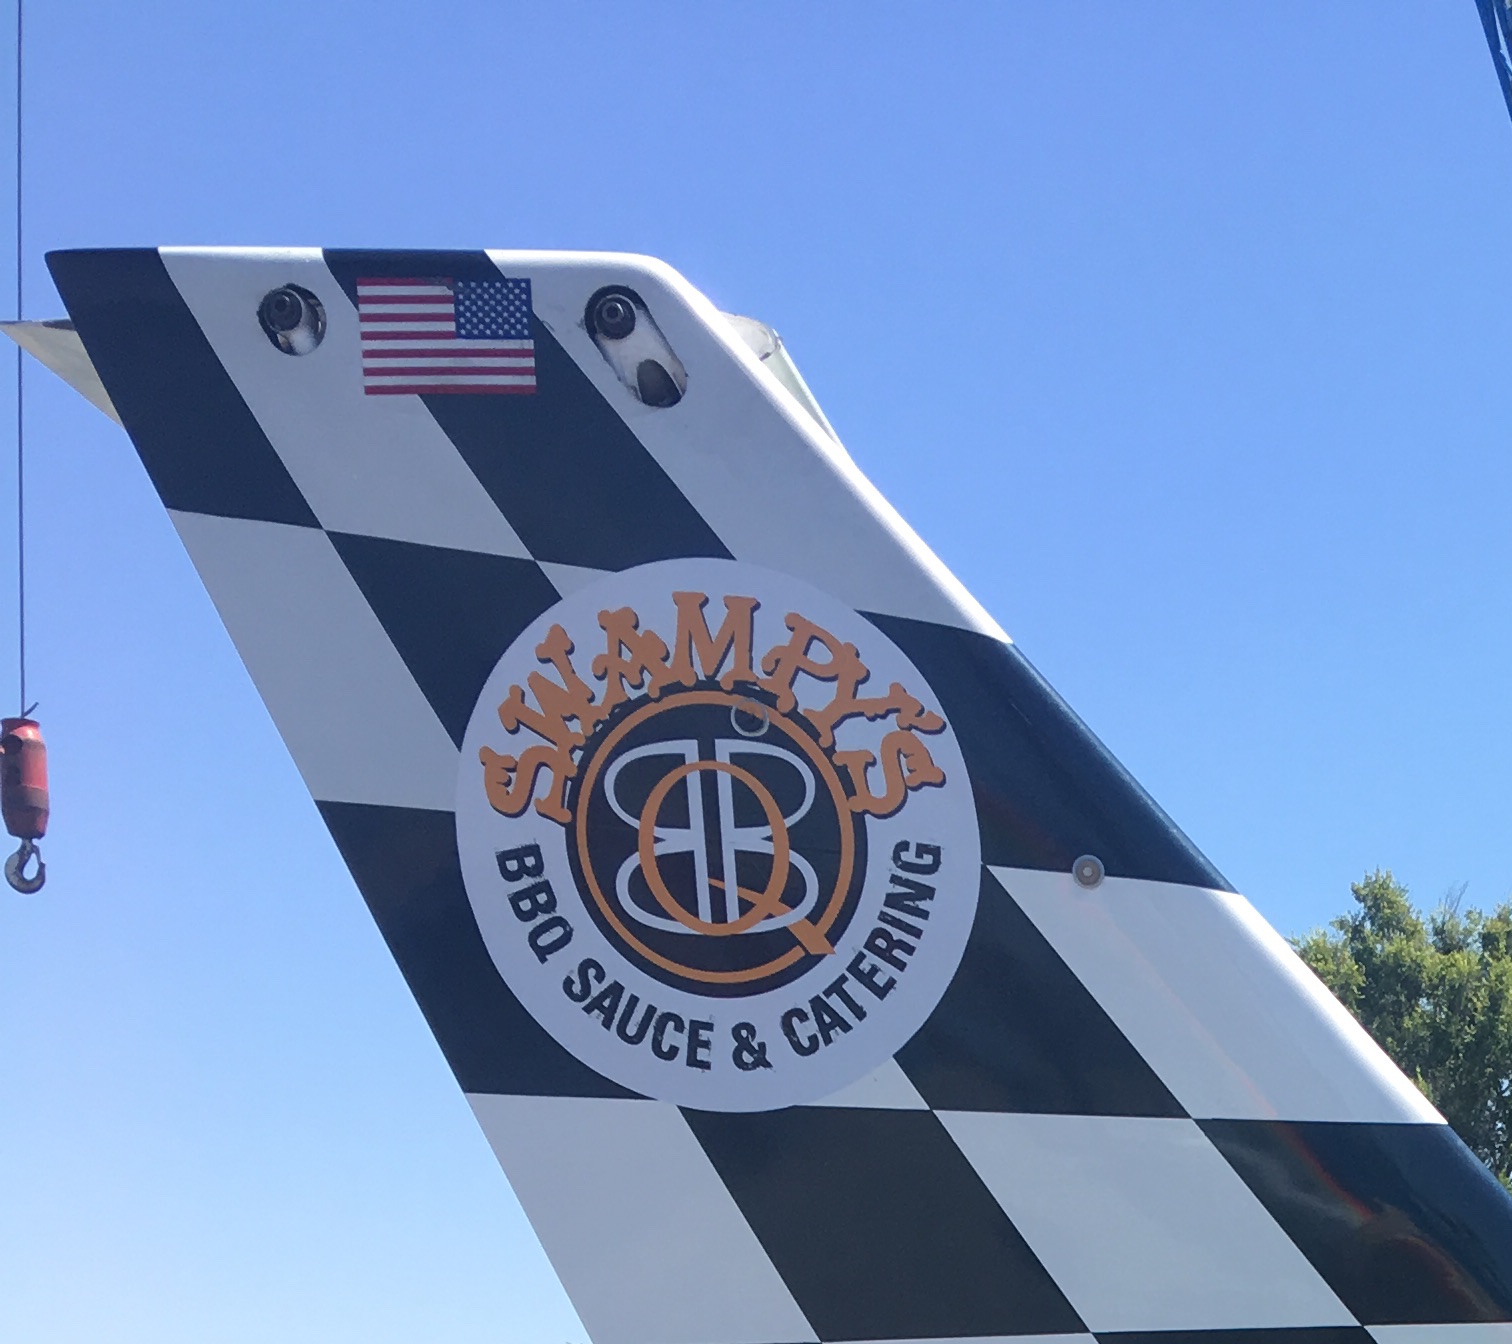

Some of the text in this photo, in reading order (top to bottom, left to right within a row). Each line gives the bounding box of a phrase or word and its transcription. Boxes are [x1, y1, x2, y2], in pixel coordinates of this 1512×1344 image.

[495, 838, 943, 1072] BBQ SAUCE & CATERING
